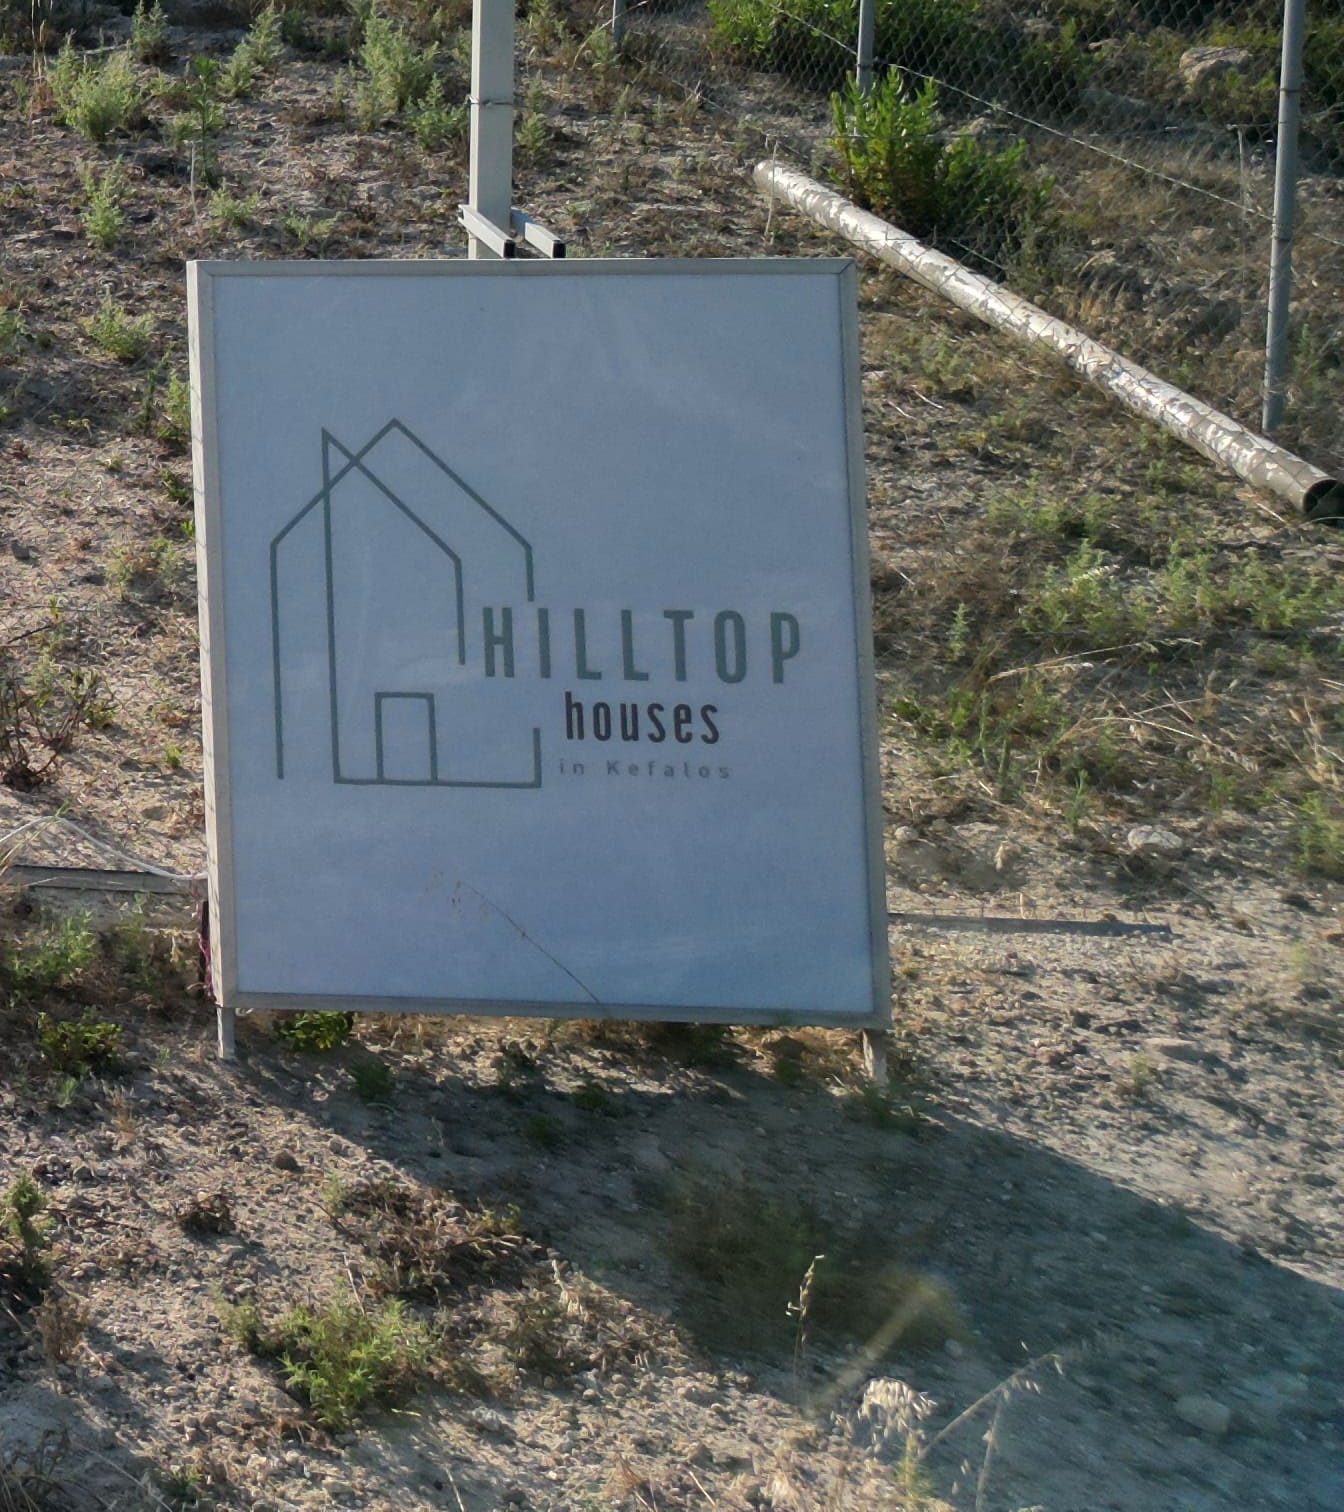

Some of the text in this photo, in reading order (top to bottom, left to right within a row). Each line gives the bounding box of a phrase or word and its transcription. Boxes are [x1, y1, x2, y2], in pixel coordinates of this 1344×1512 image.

[483, 607, 801, 684] HILLTOP
[565, 691, 720, 745] houses
[559, 758, 730, 779] in Kefalos
